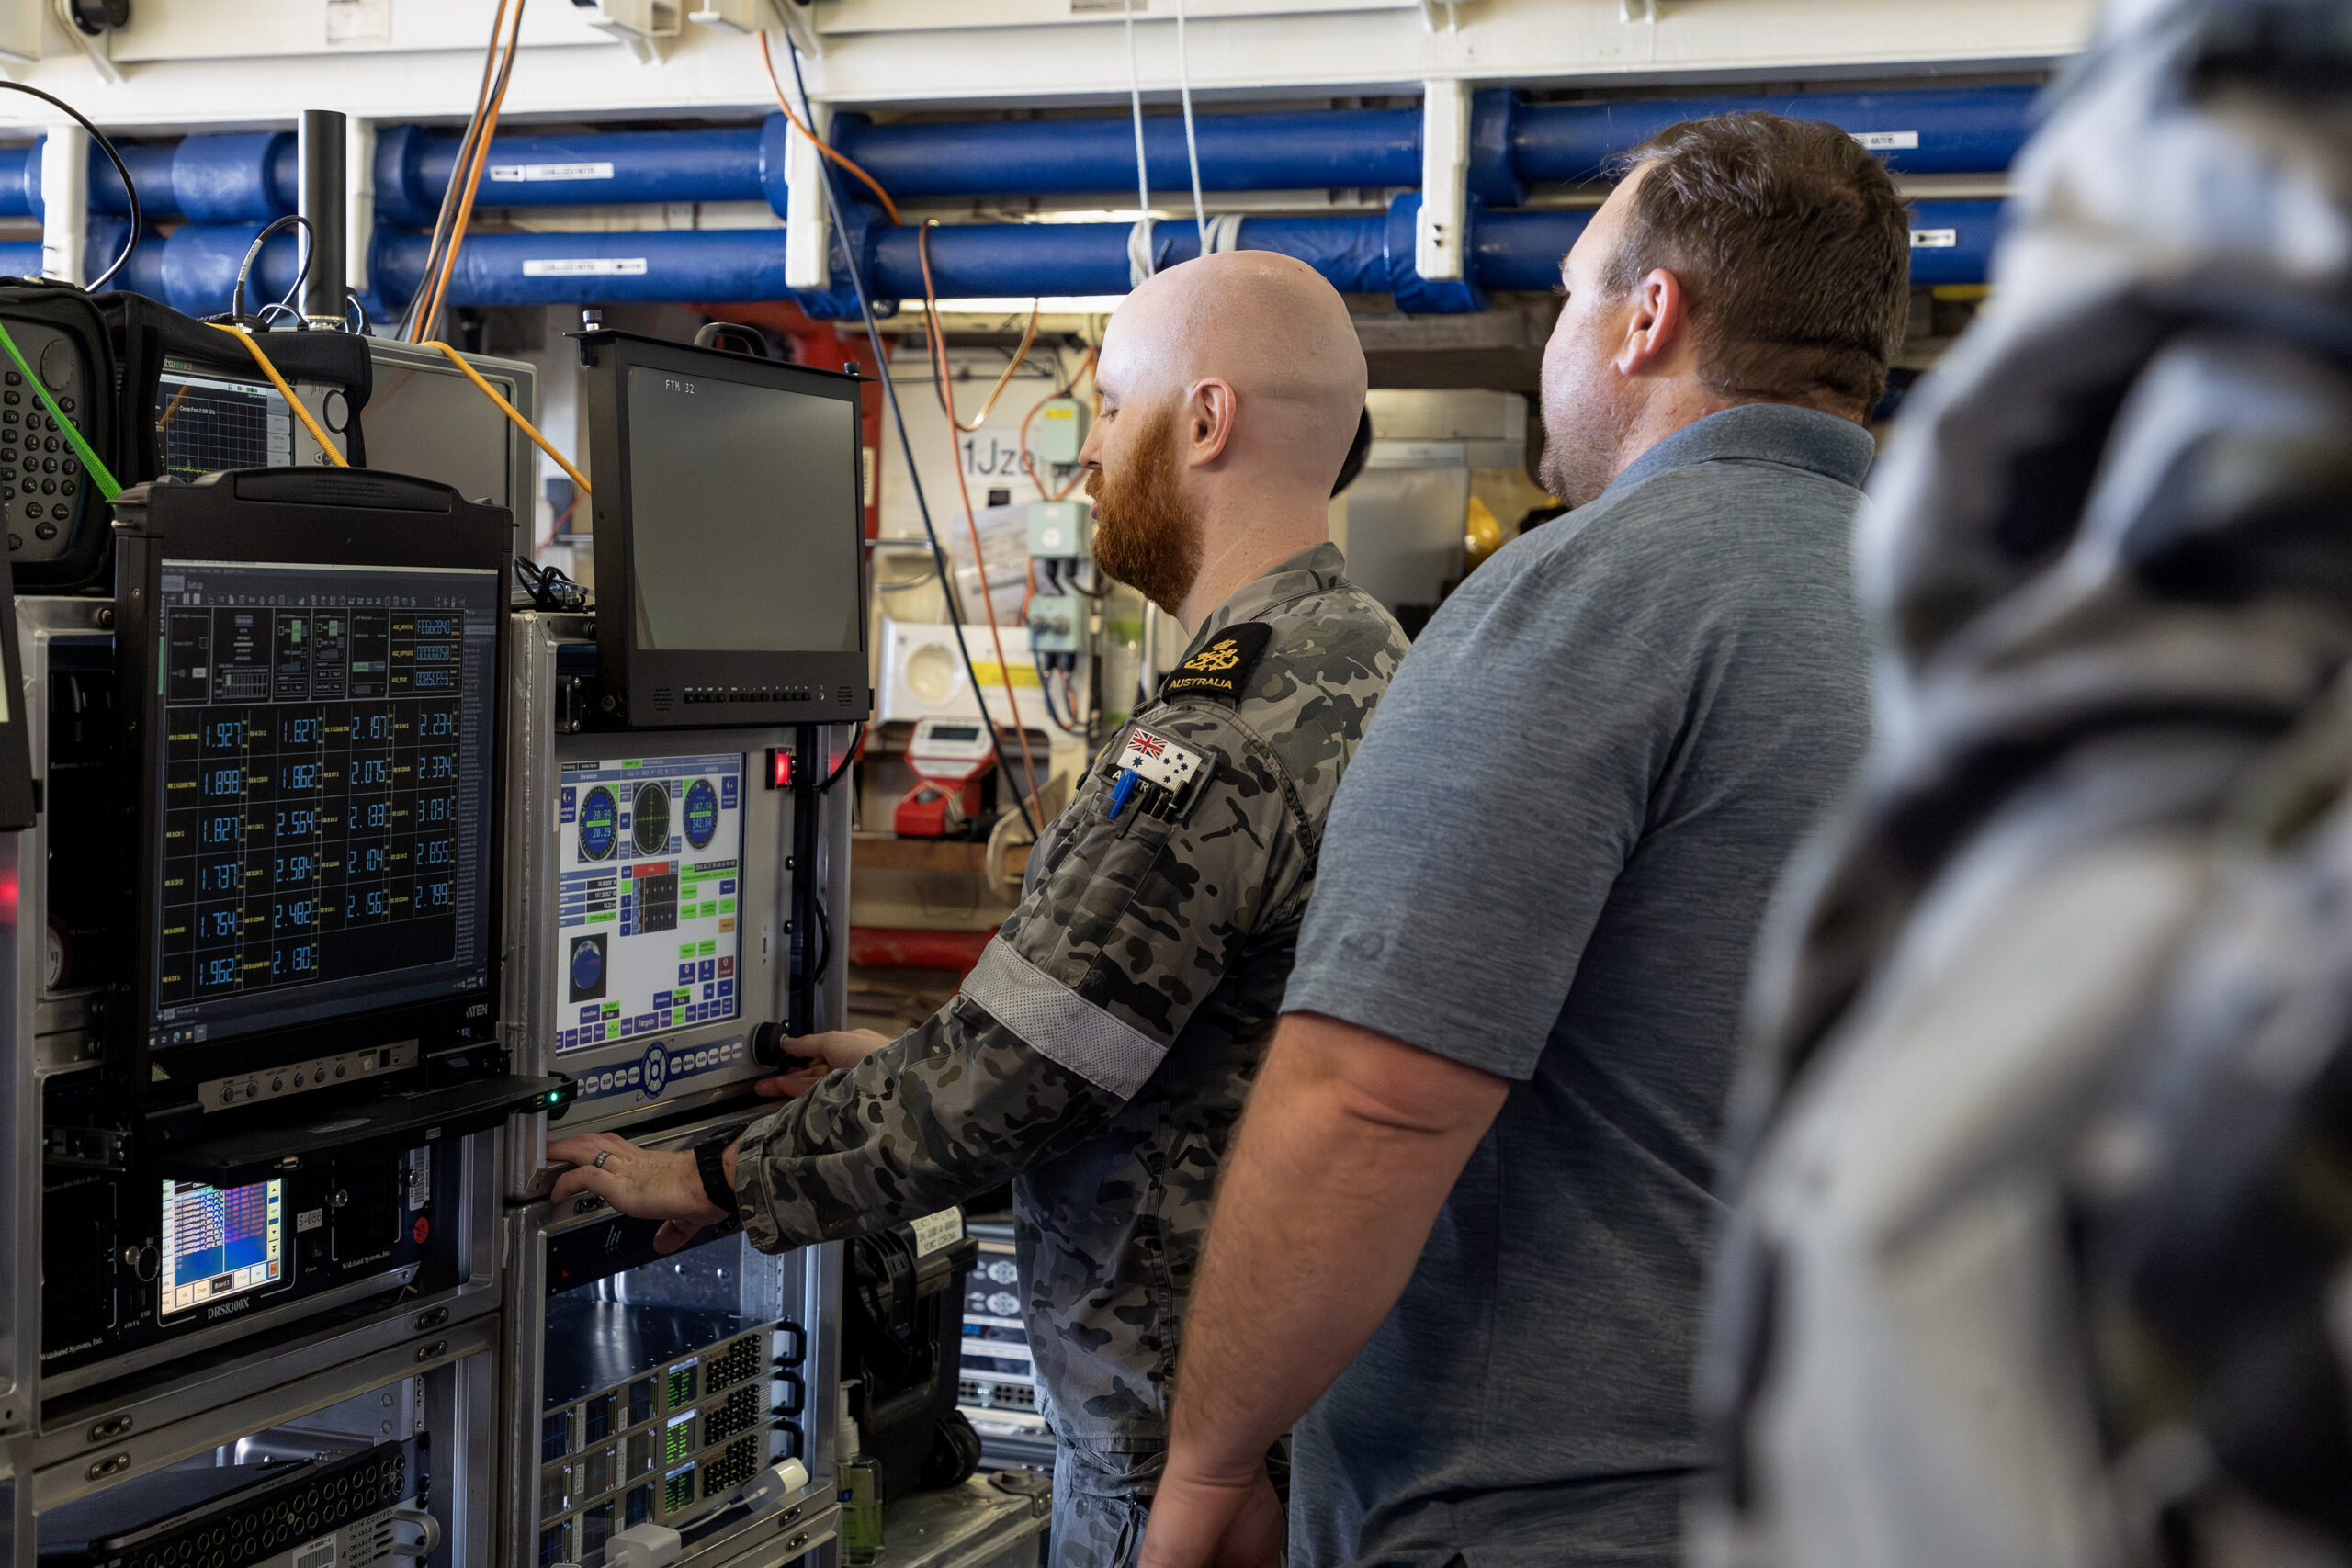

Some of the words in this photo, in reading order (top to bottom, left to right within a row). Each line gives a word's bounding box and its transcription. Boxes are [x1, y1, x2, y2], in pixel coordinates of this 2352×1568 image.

[665, 379, 681, 392] FTM
[684, 382, 695, 394] 32
[1168, 677, 1233, 691] AUSTRALIA
[206, 723, 241, 747] 1.927
[285, 720, 316, 742] 1.827
[353, 716, 386, 739] 2.197
[421, 715, 452, 735] 2.234
[284, 765, 315, 788] 1.862
[351, 760, 385, 784] 2.075
[419, 757, 451, 779] 2.334
[206, 770, 239, 795] 1.898
[351, 804, 384, 829] 2.133
[419, 799, 450, 821] 3.031
[204, 817, 238, 842] 1.827
[277, 811, 313, 836] 2.564
[349, 849, 382, 873] 2.104
[418, 841, 448, 864] 2.855
[203, 864, 237, 889] 1.737
[276, 856, 312, 882] 2.584
[347, 892, 381, 918] 2.156
[416, 883, 447, 908] 2.799
[201, 911, 235, 937] 1.754
[275, 901, 311, 928] 2.482
[200, 958, 234, 985] 1.962
[274, 946, 310, 974] 2.130
[466, 1003, 488, 1019] ATEN
[638, 1018, 654, 1028] Targets
[299, 1212, 322, 1226] S-086
[207, 1296, 250, 1321] DRS8300X
